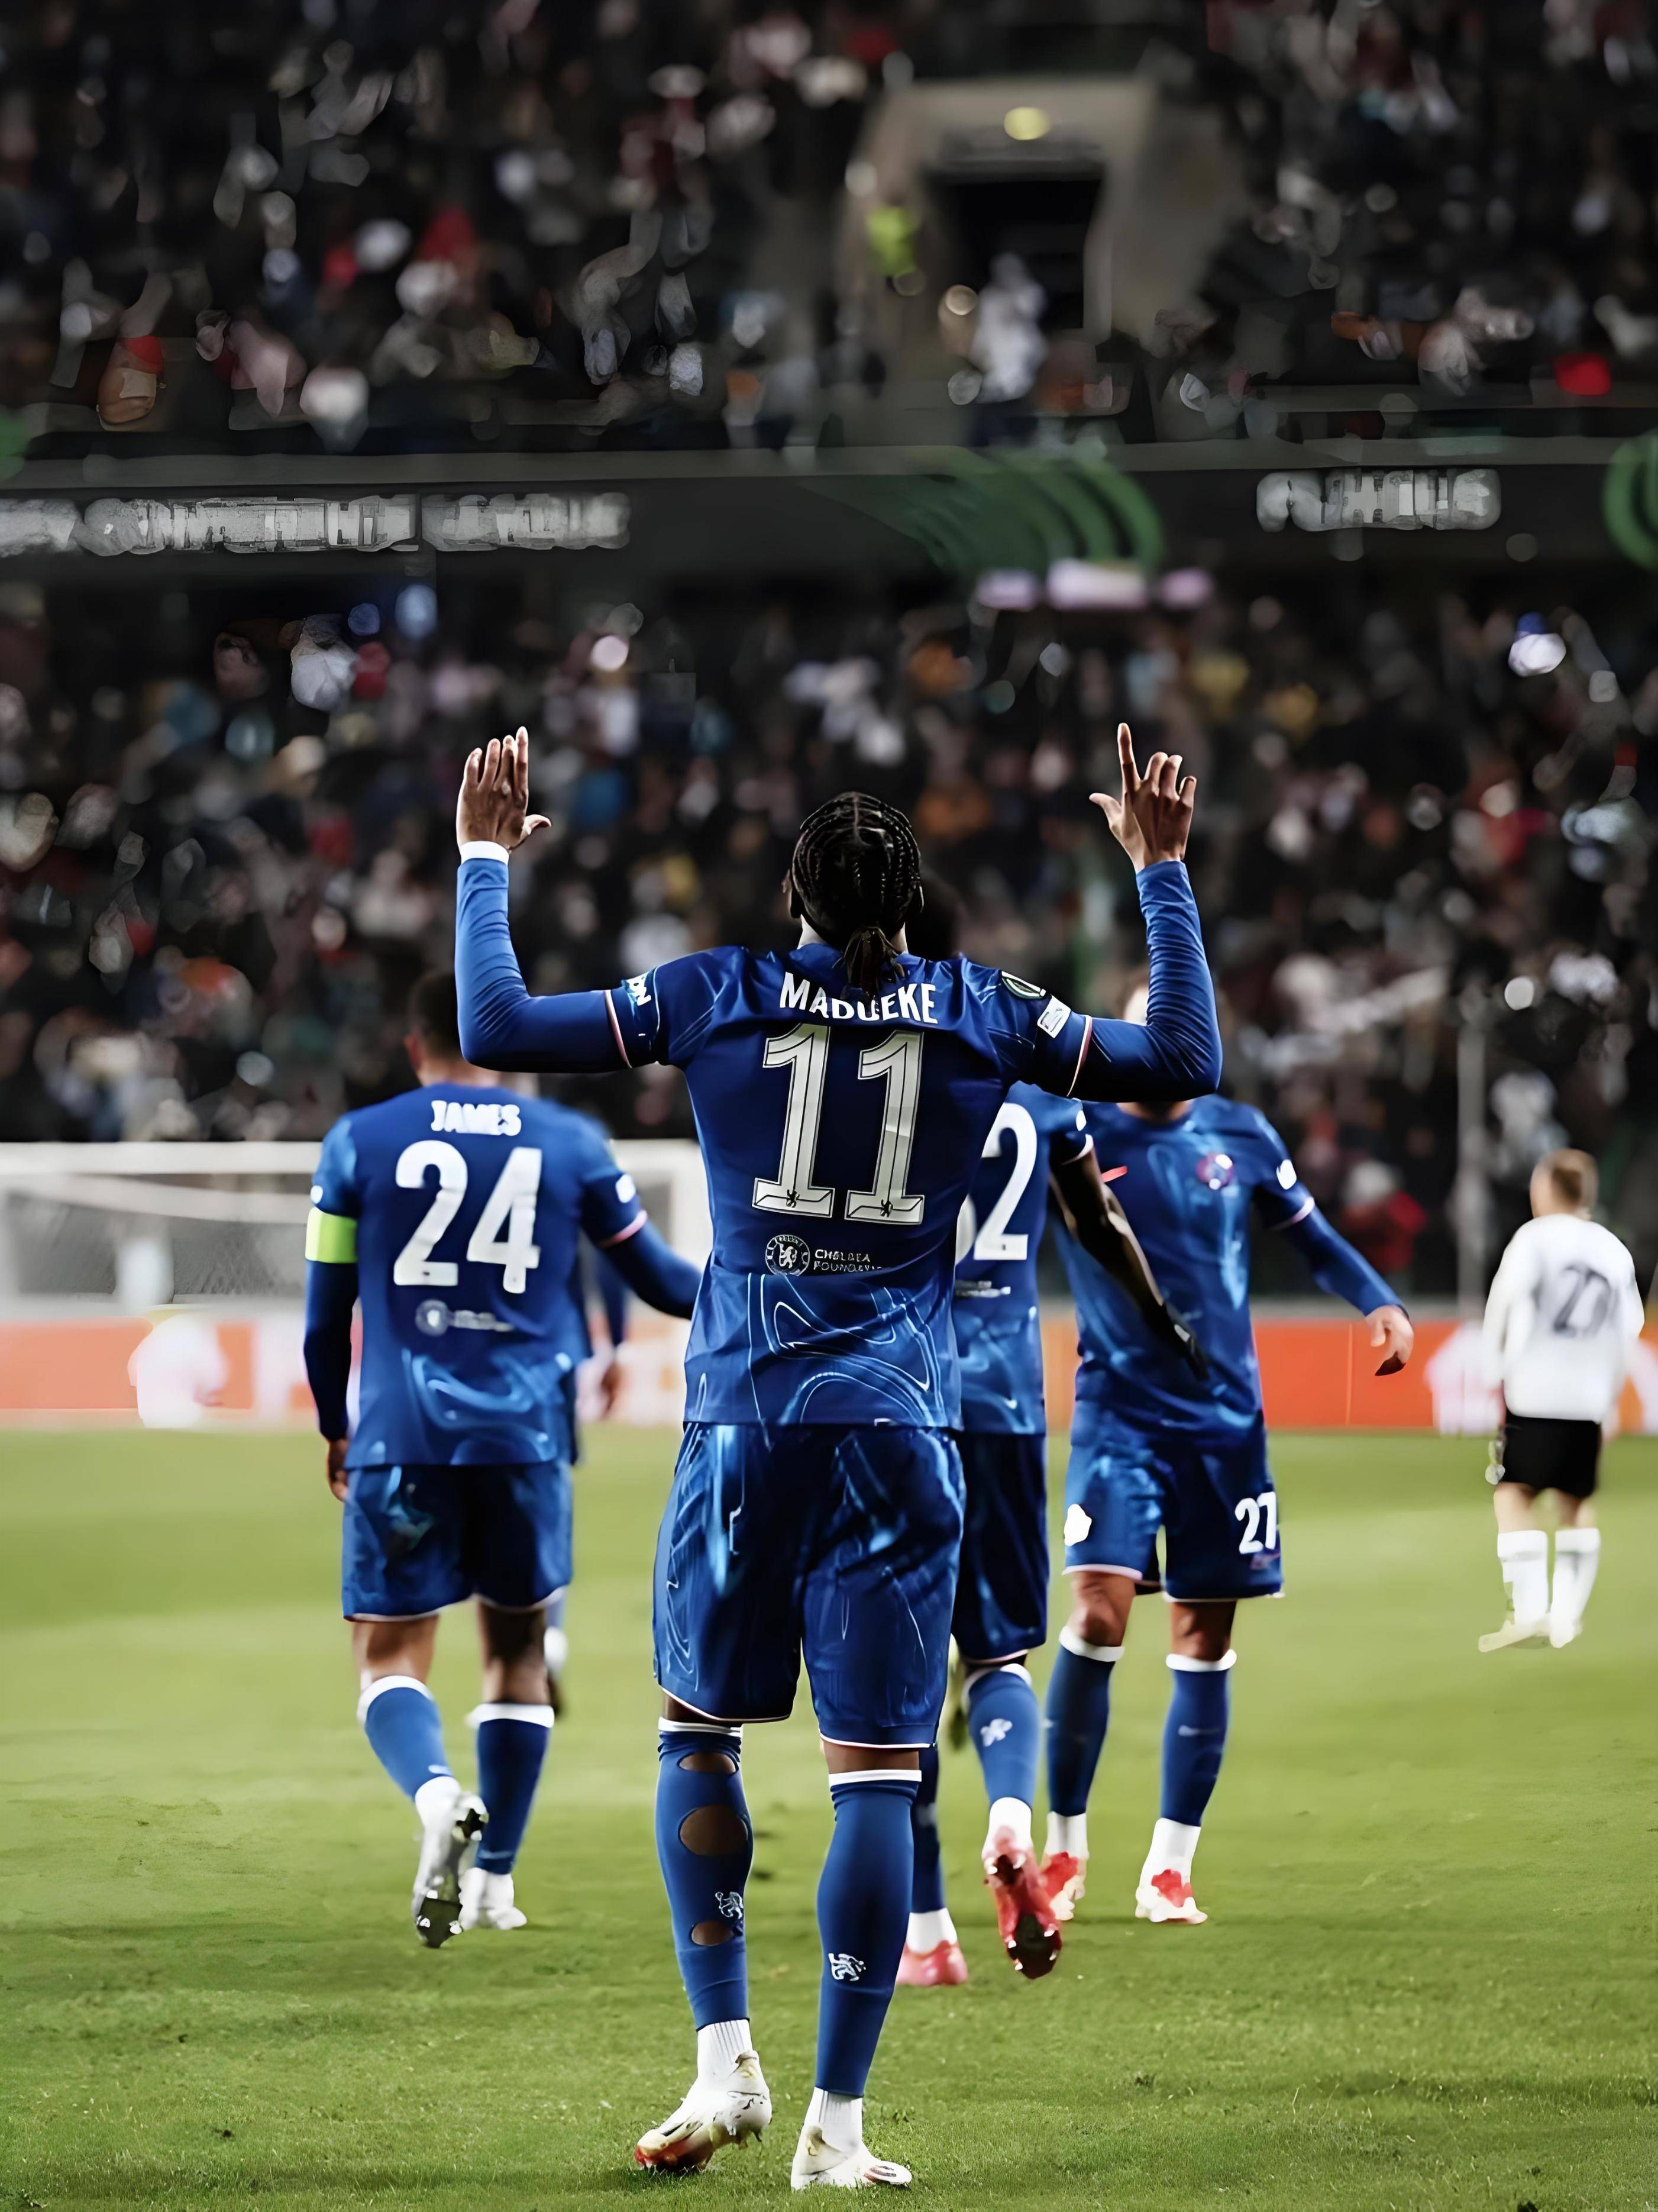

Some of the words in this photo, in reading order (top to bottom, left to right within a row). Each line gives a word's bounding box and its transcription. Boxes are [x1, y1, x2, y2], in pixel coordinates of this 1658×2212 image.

[780, 971, 938, 1024] MADUEKE
[431, 1100, 522, 1136] JAMES
[752, 1023, 925, 1225] 11
[393, 1140, 542, 1294] 24
